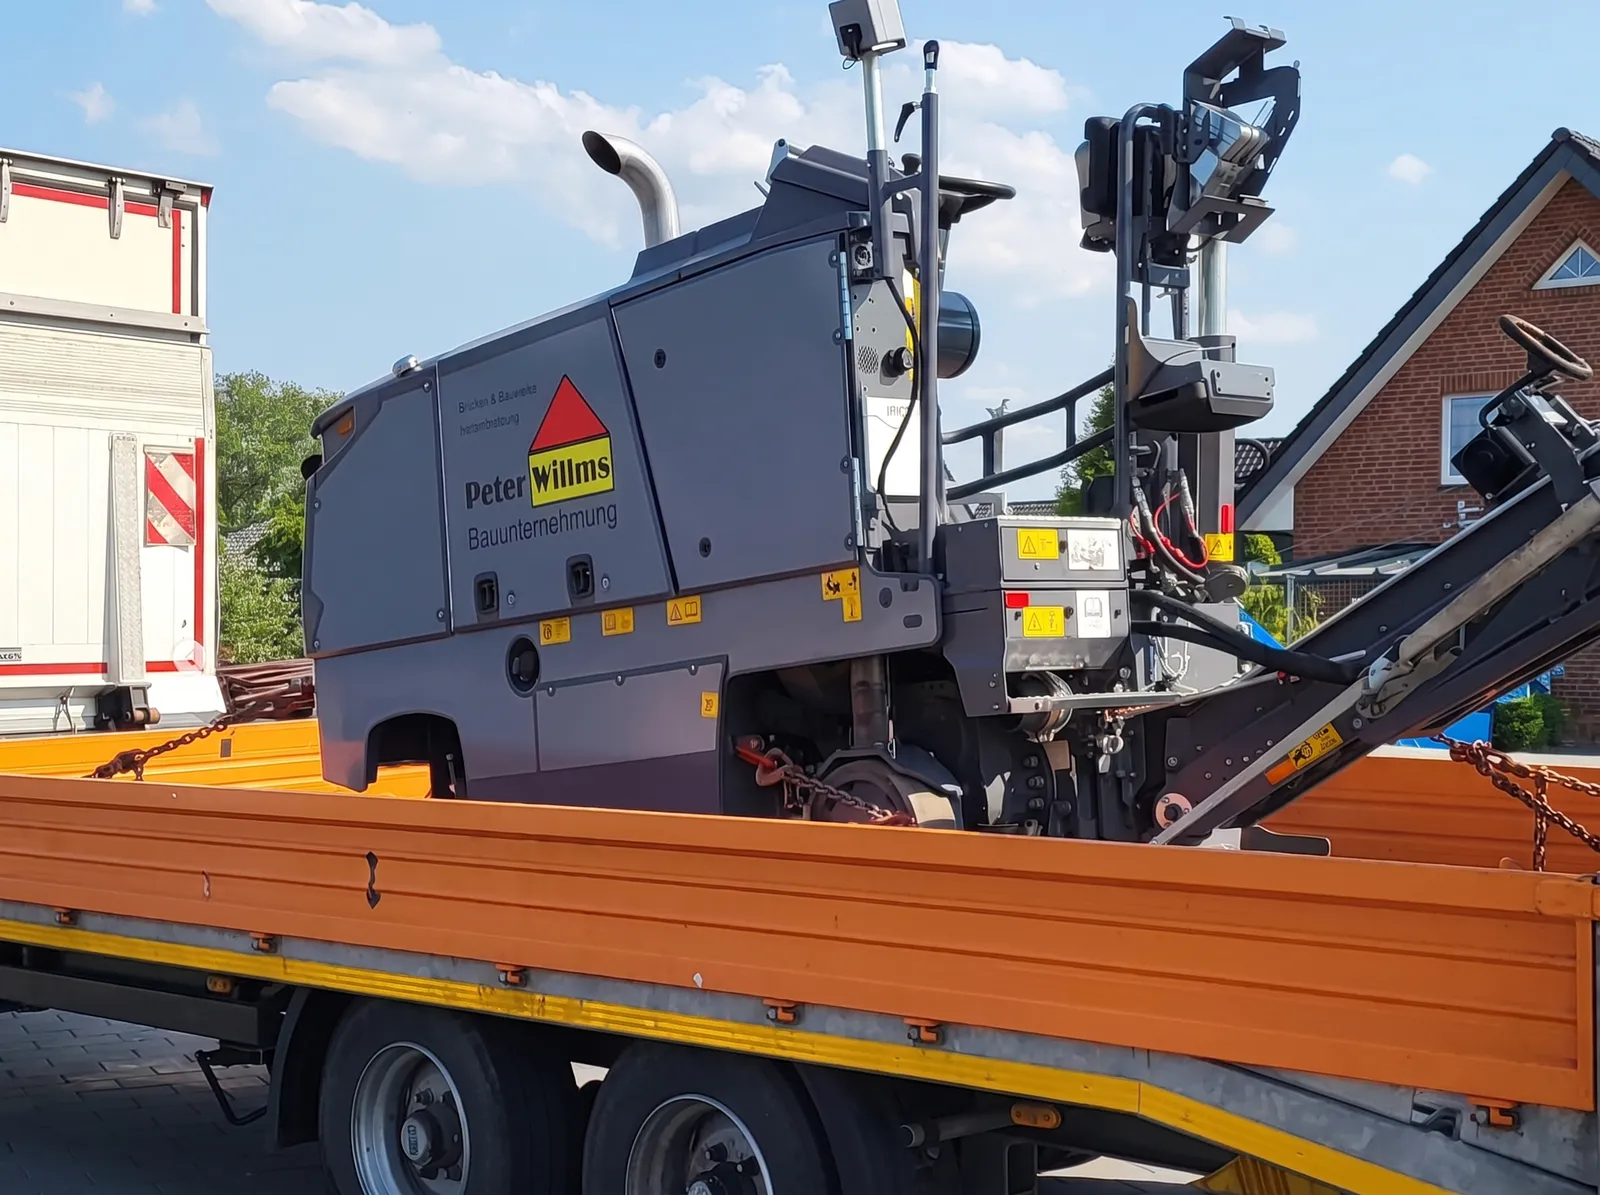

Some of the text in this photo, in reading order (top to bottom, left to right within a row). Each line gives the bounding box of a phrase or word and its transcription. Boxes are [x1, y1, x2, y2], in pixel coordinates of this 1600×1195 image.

[465, 456, 610, 509] Peter Willms
[468, 503, 617, 550] Bauunternehmung
